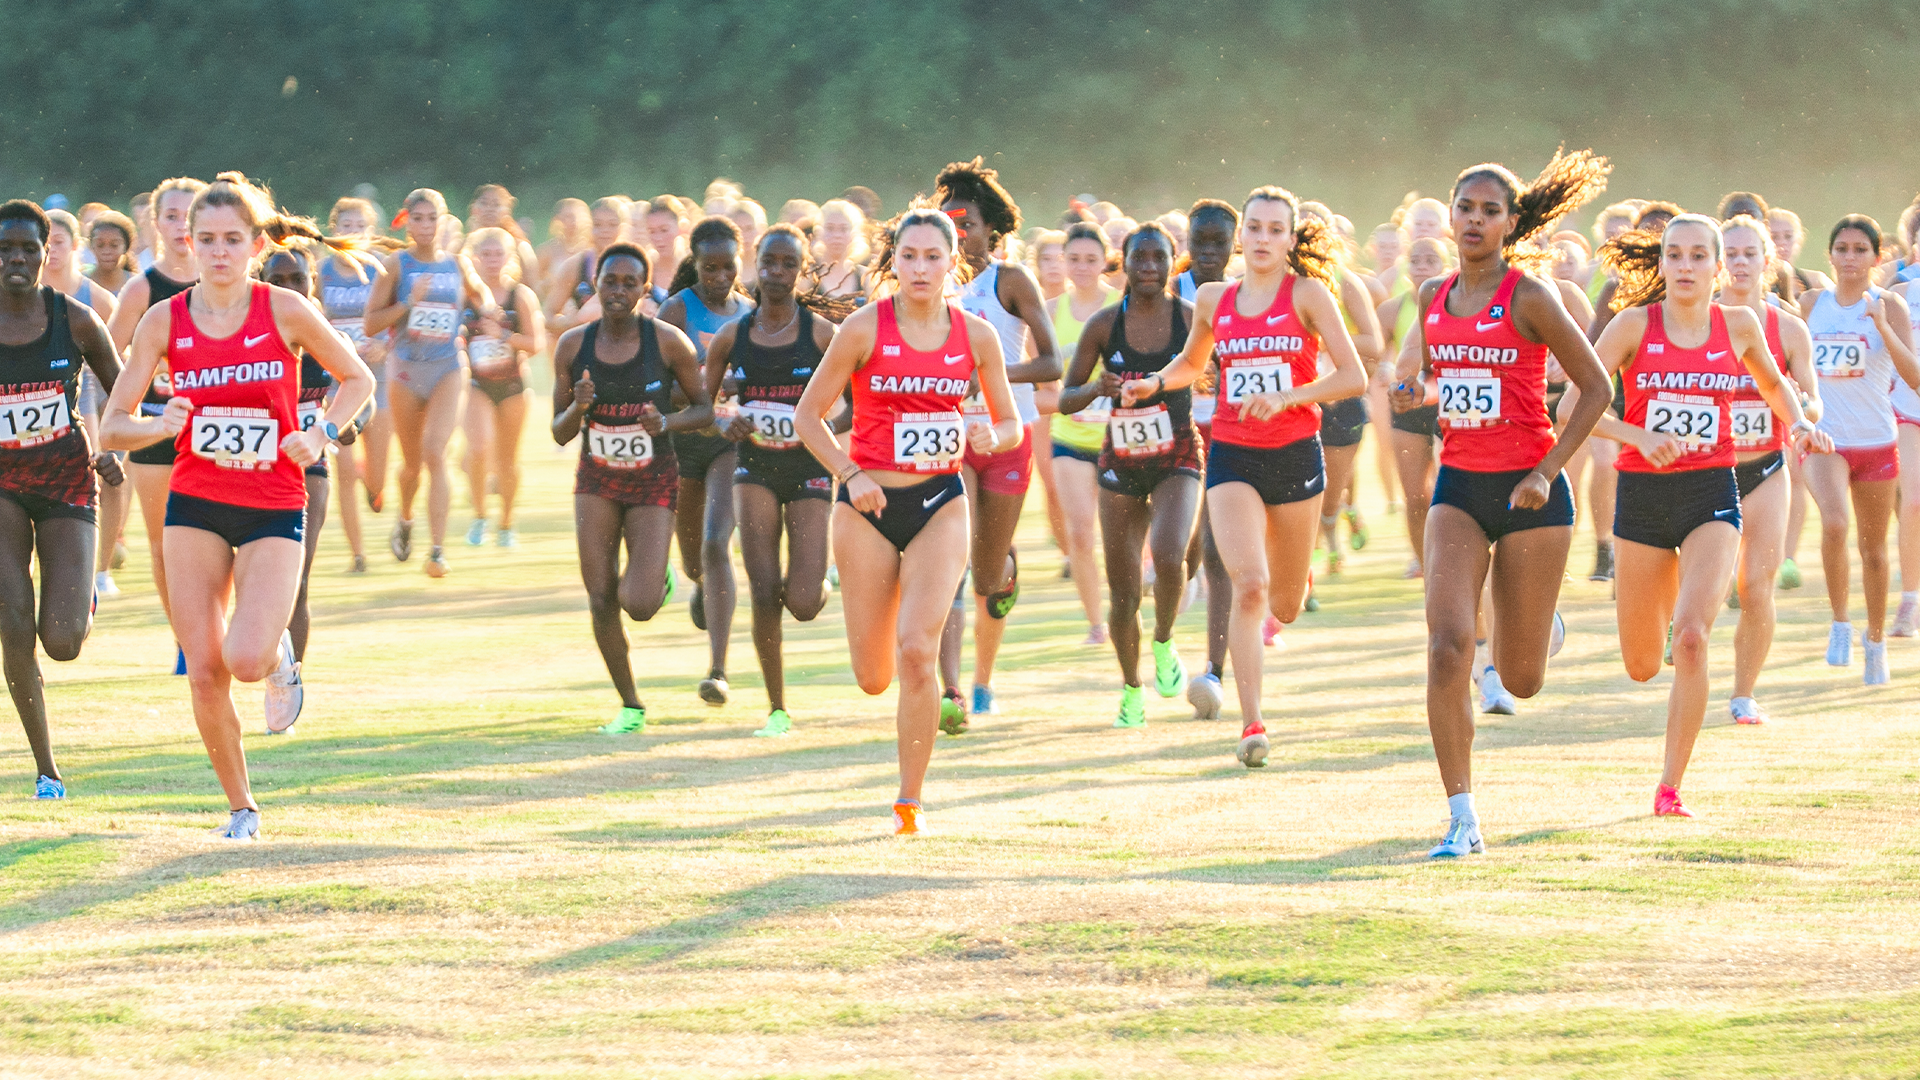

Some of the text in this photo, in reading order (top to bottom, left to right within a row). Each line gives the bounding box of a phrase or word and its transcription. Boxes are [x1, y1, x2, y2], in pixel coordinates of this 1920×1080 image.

[415, 311, 451, 329] 293
[1815, 344, 1860, 366] 279
[174, 360, 284, 390] SAMFORD
[1232, 369, 1282, 397] 231
[202, 406, 270, 418] FOOTHILLS INVITATIONAL
[1442, 384, 1493, 413] 235
[3, 401, 60, 435] 127
[1117, 418, 1163, 444] 131
[1652, 407, 1713, 438] 232
[200, 422, 270, 454] 237
[595, 436, 646, 457] 126
[902, 427, 960, 456] 233
